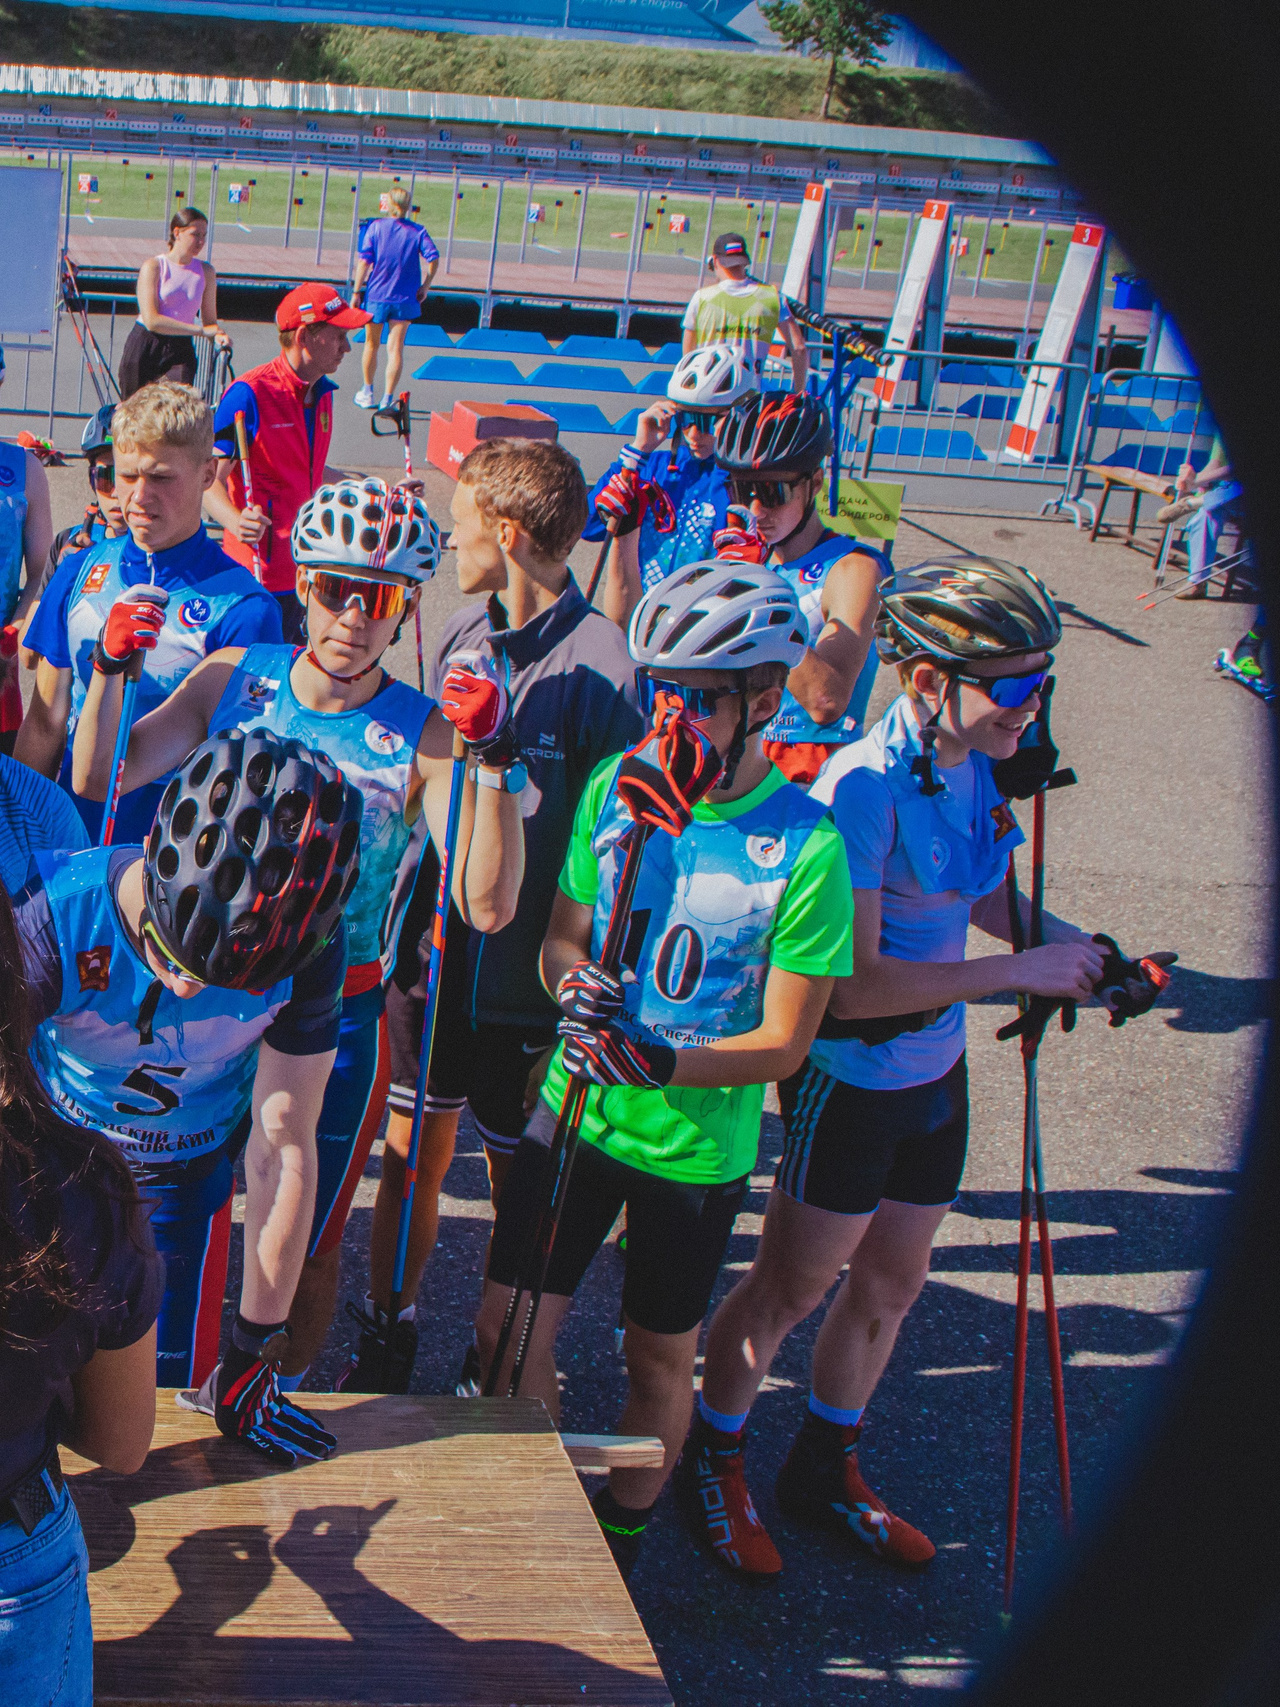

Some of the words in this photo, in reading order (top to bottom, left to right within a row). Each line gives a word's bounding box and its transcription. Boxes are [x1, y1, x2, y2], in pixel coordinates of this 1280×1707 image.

[930, 204, 938, 219] 2
[1082, 228, 1092, 243] 3
[822, 494, 869, 506] ВДАЧА
[586, 965, 601, 978] SKI
[115, 1063, 188, 1117] 5
